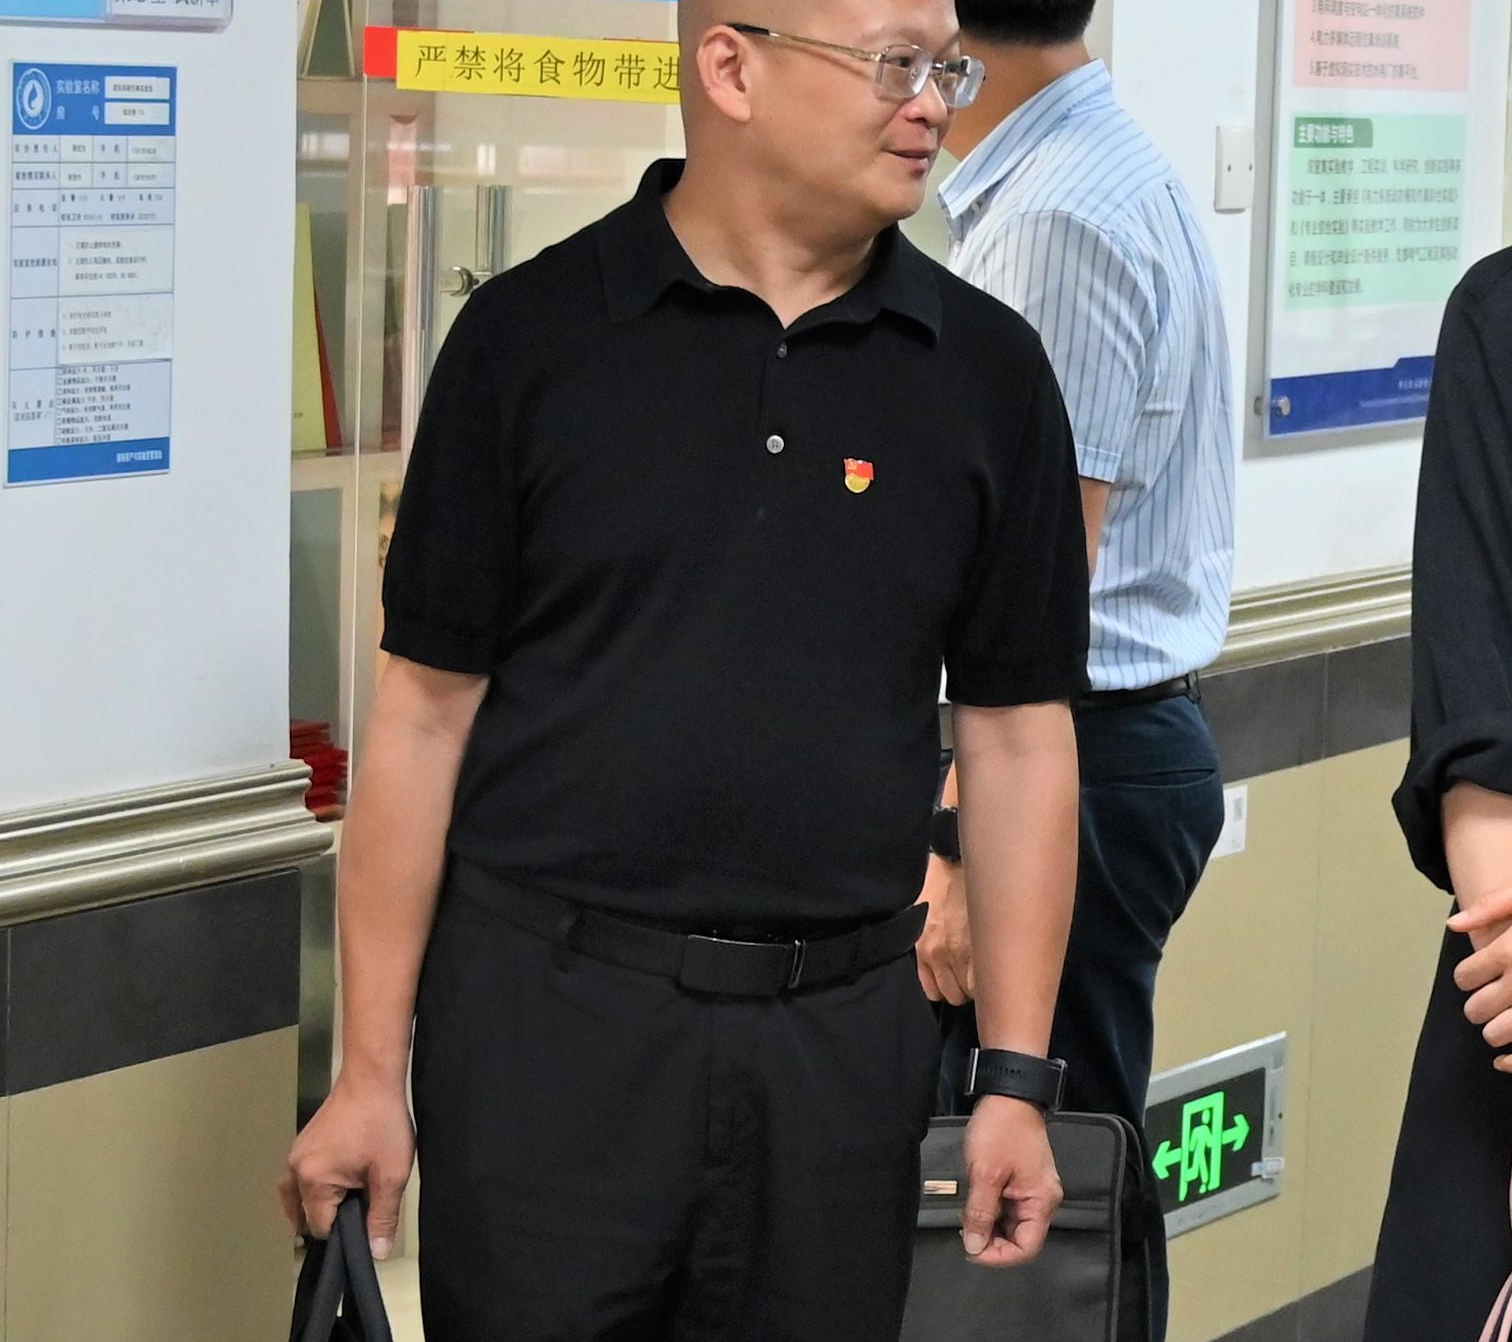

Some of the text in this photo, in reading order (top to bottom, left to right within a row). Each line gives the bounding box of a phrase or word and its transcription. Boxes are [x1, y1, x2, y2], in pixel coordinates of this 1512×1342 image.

[414, 43, 681, 92] 严禁将食物带进
